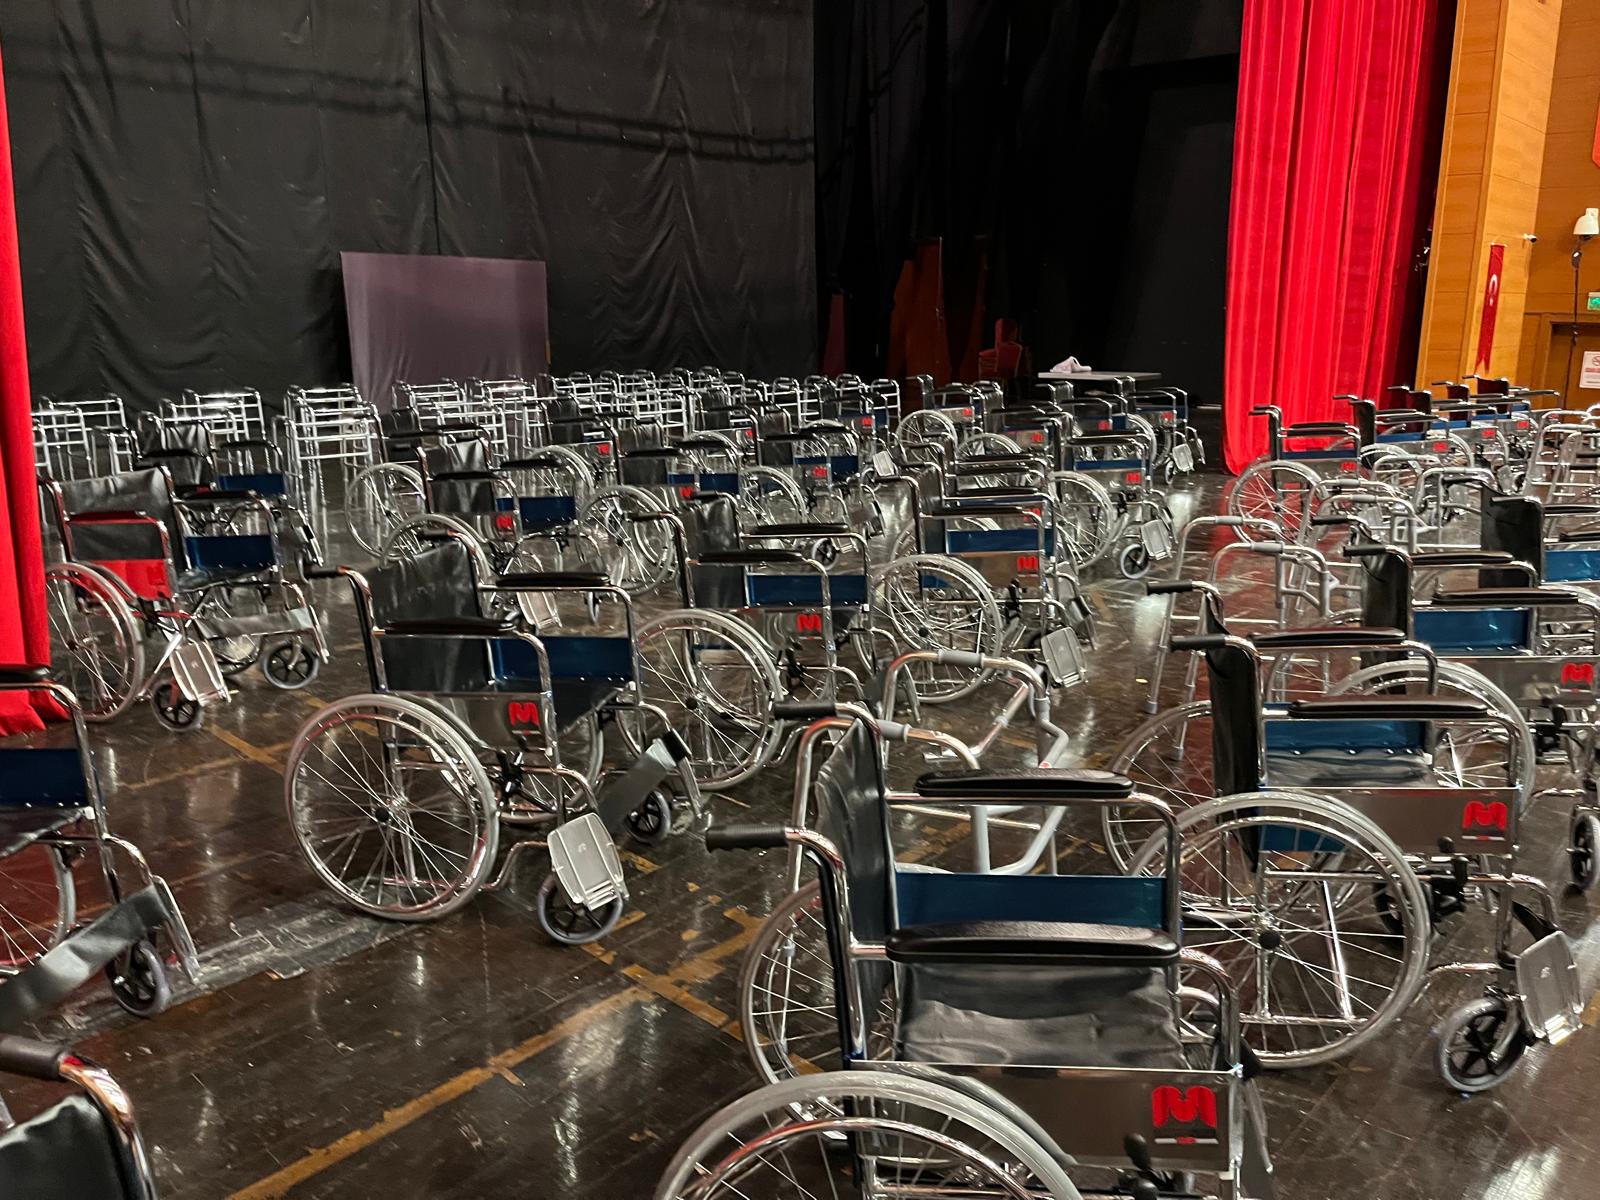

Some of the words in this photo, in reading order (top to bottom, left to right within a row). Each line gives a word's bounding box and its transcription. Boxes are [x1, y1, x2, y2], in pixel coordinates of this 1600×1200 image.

[1562, 663, 1594, 684] M
[508, 702, 540, 726] M
[1462, 800, 1508, 830] M
[1151, 1085, 1217, 1128] M
